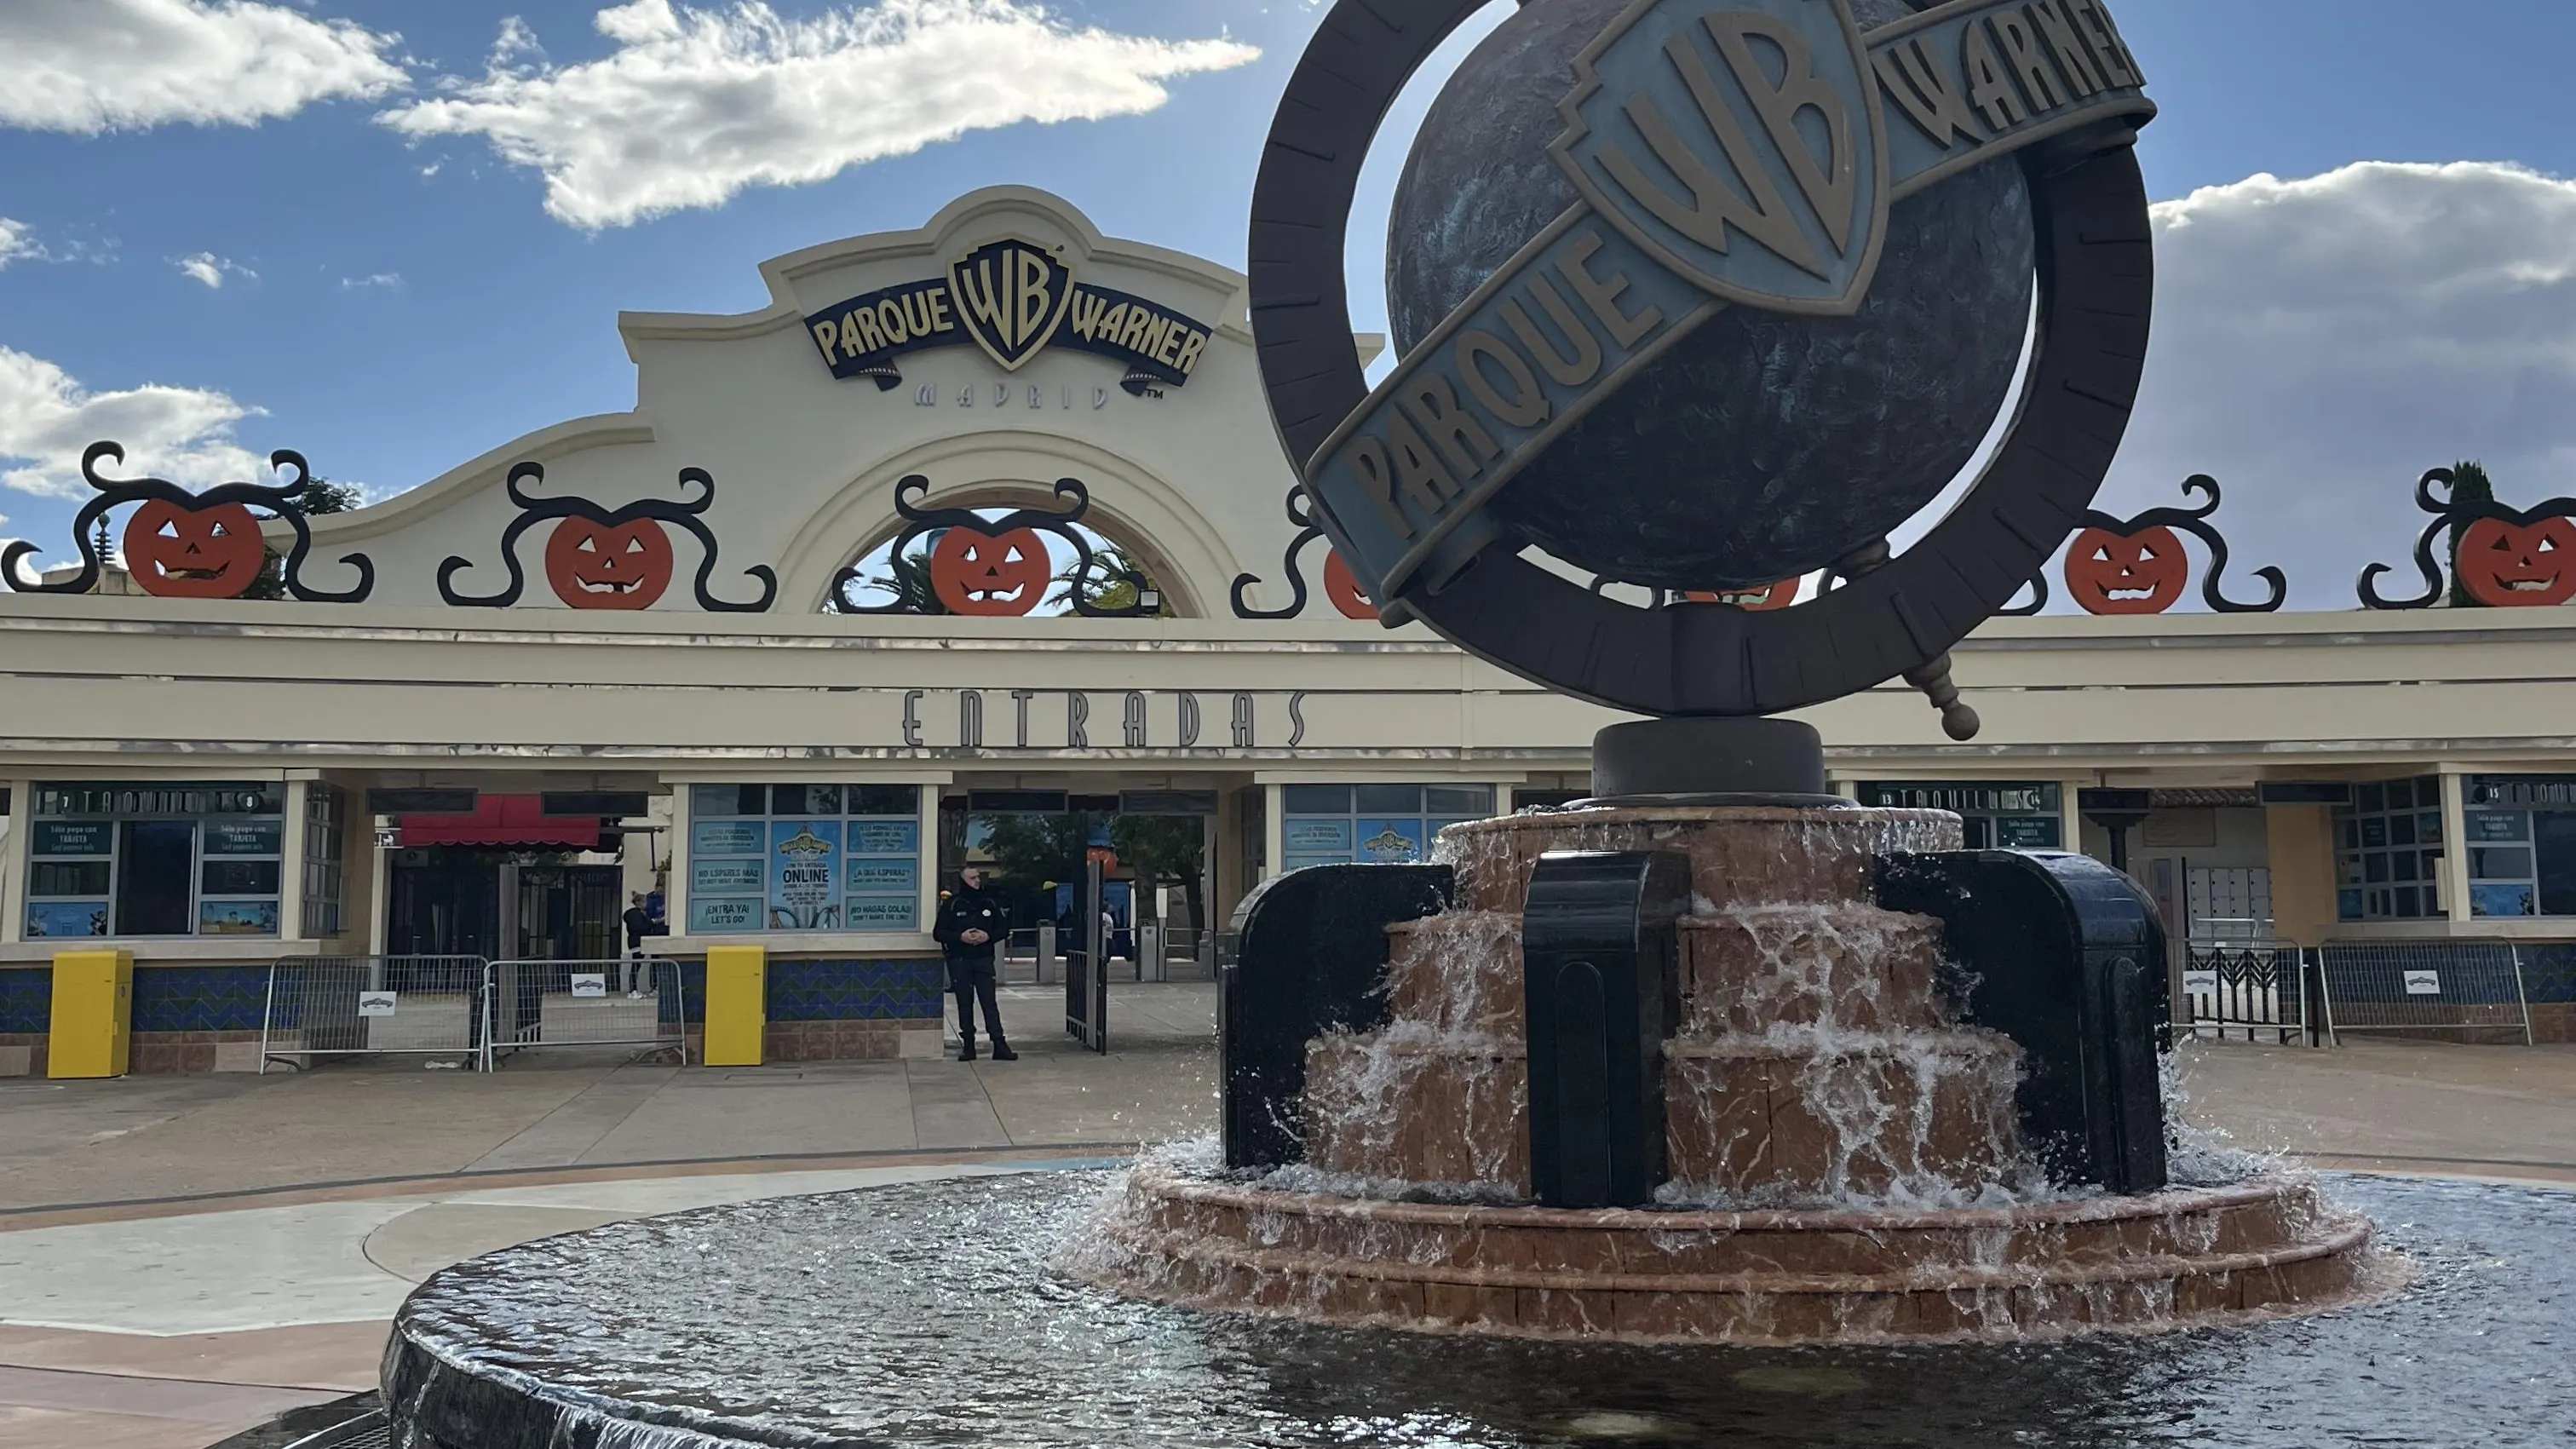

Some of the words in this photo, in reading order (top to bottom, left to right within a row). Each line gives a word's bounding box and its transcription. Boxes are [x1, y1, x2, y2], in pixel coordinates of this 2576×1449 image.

[1348, 231, 1664, 540] PARQUE
[1594, 11, 1854, 282] WB
[1870, 0, 2147, 151] WARNER
[814, 288, 953, 366] PARQUE
[963, 249, 1049, 351] WB
[1072, 289, 1209, 375] WARNER
[914, 383, 1107, 410] MADRID
[902, 690, 1305, 746] ENTRADAS
[1882, 794, 1892, 804] 13
[784, 869, 829, 883] ONLINE
[705, 905, 734, 915] ¡ENTRA
[736, 904, 750, 913] YA!
[863, 905, 886, 913] HAGAS
[733, 915, 745, 923] GO!
